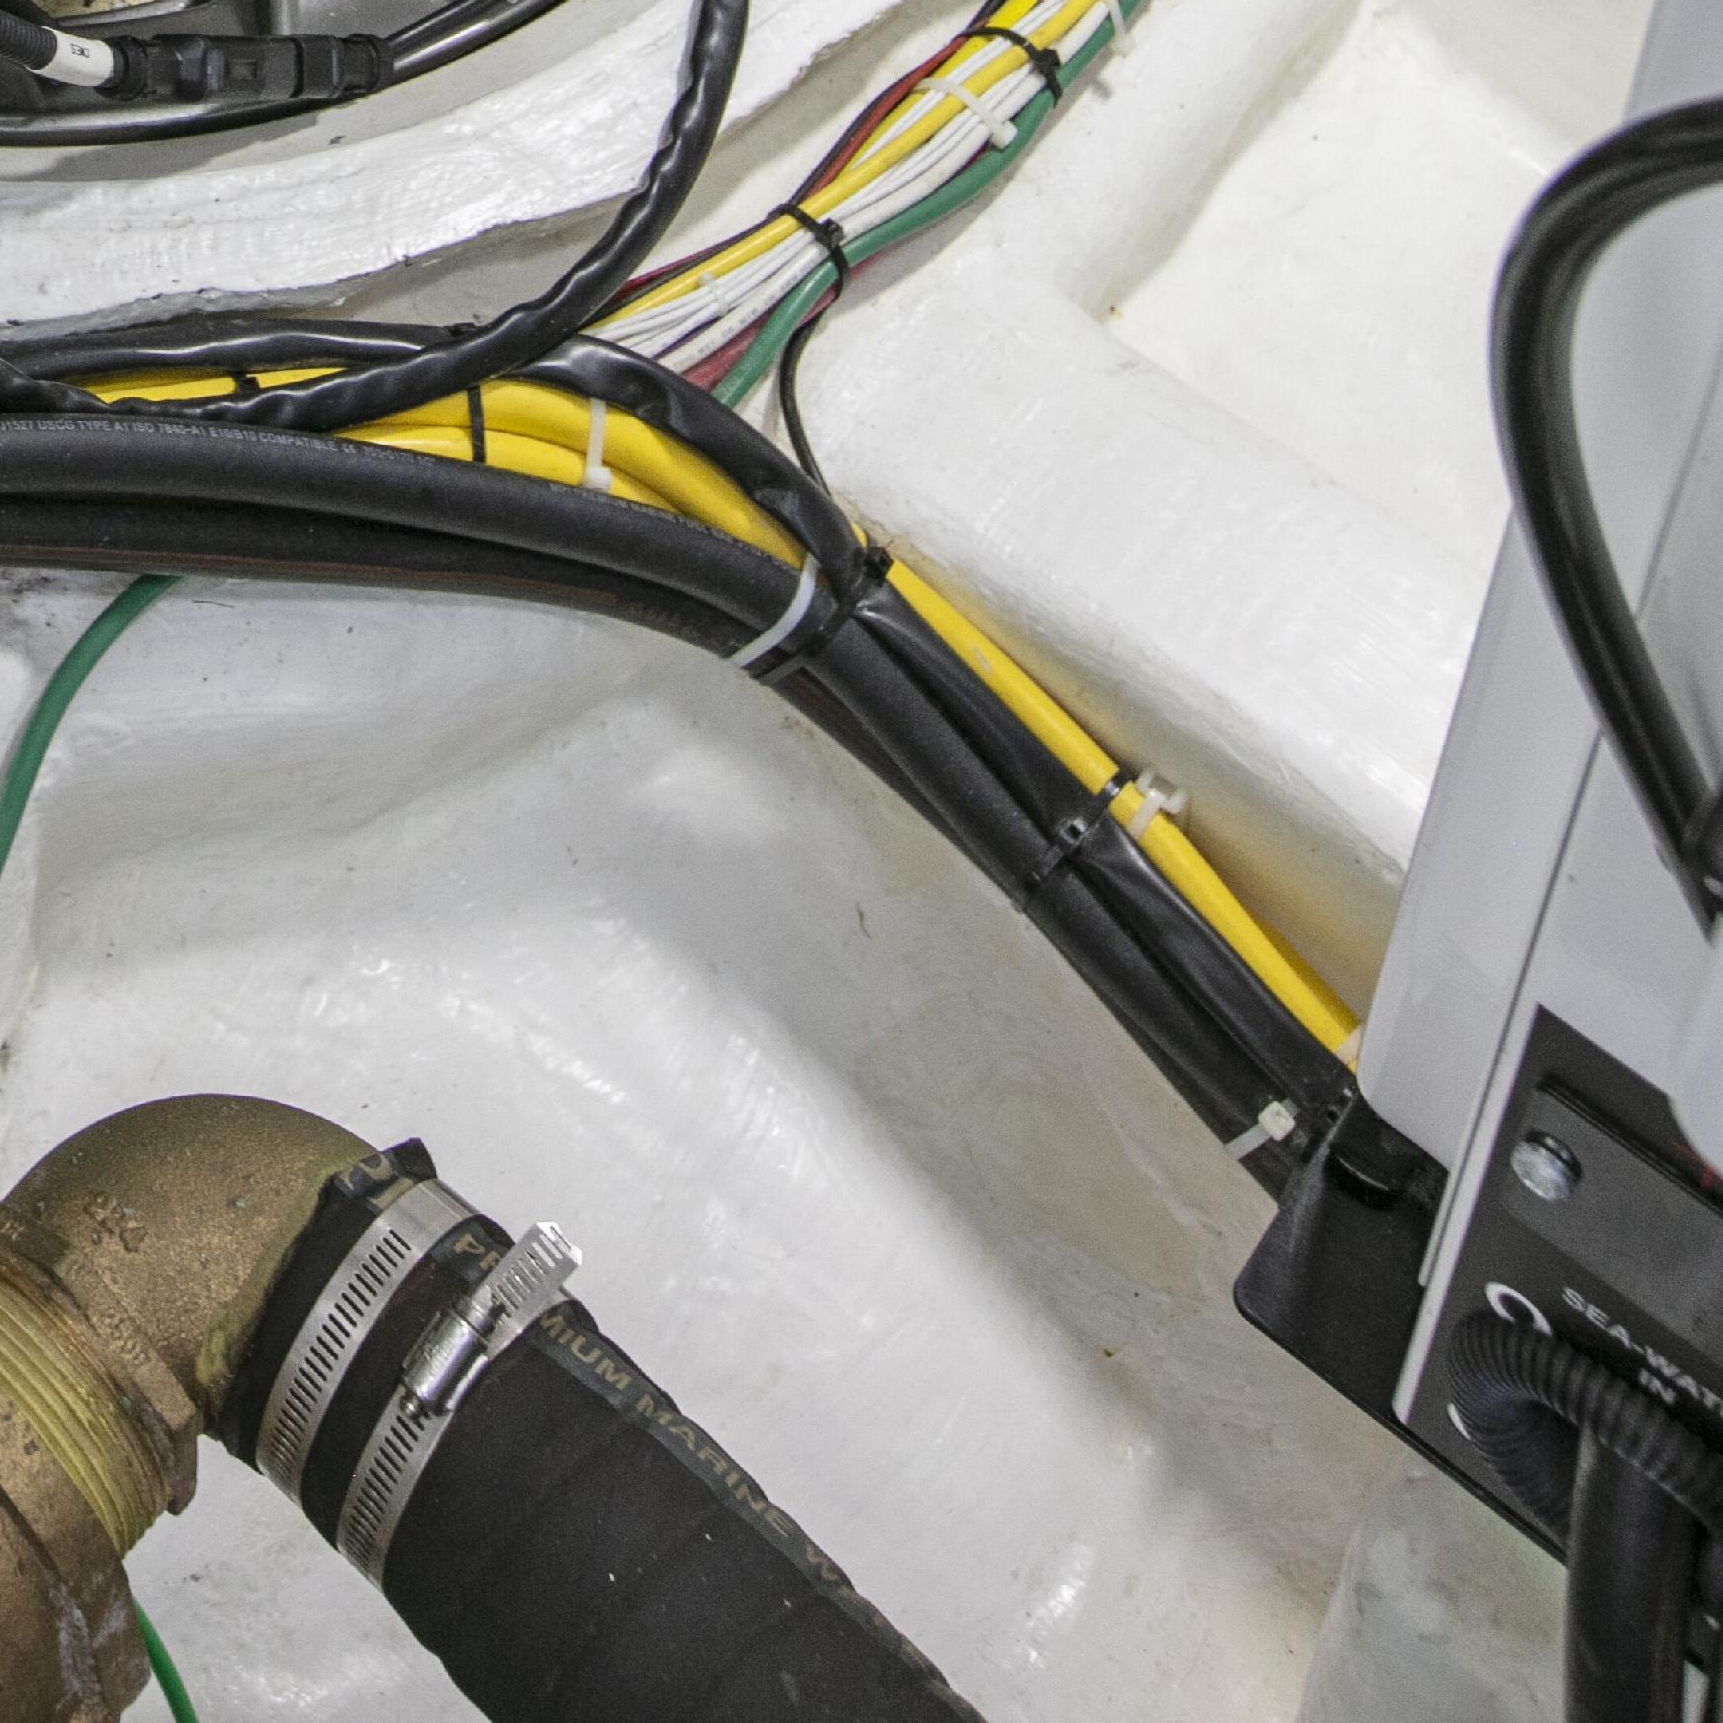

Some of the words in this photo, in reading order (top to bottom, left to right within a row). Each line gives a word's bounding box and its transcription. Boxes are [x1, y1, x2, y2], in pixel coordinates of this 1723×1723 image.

[0, 419, 35, 432] J1527
[37, 419, 75, 432] USCG
[76, 419, 111, 432] TYPE
[132, 421, 155, 434] ISO
[259, 430, 338, 452] COMPATIBLE
[1562, 1286, 1723, 1420] SEA-WAT
[1639, 1367, 1676, 1404] IN
[633, 1391, 790, 1538] MARINE
